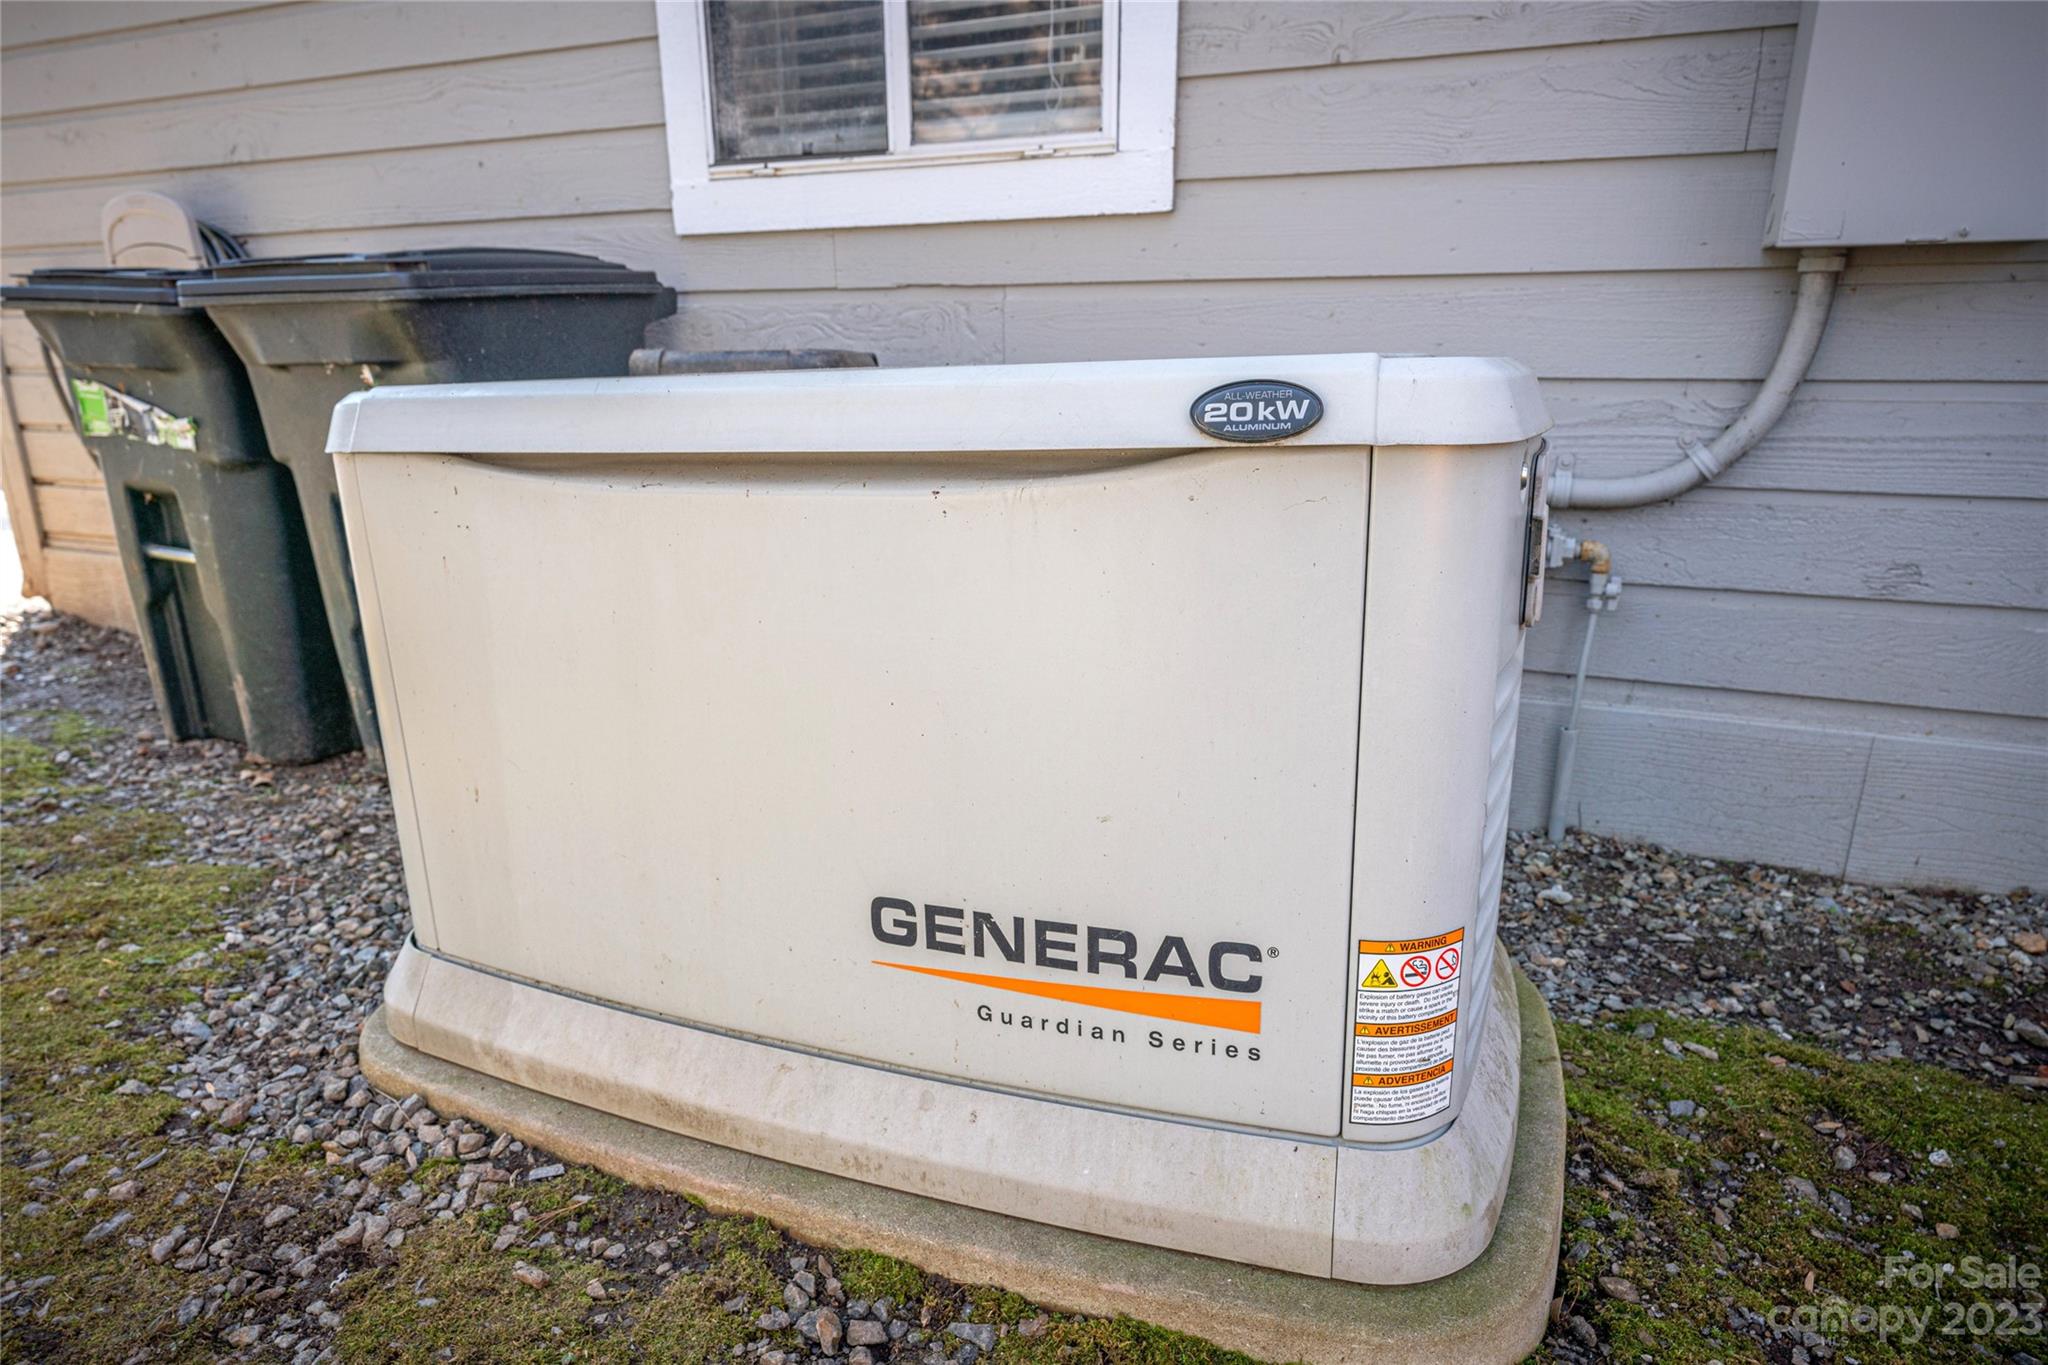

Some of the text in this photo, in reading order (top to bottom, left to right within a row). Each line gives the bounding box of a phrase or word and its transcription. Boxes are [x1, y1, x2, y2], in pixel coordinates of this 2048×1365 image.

[1224, 389, 1293, 401] ALL-WEATHER
[1223, 422, 1292, 432] ALUMINUM
[1400, 937, 1447, 952] WARNING
[1375, 1013, 1454, 1034] AVERTISSEMENT
[977, 1005, 1262, 1061] Guardian Series
[1378, 1065, 1446, 1085] ADVERTENCIA
